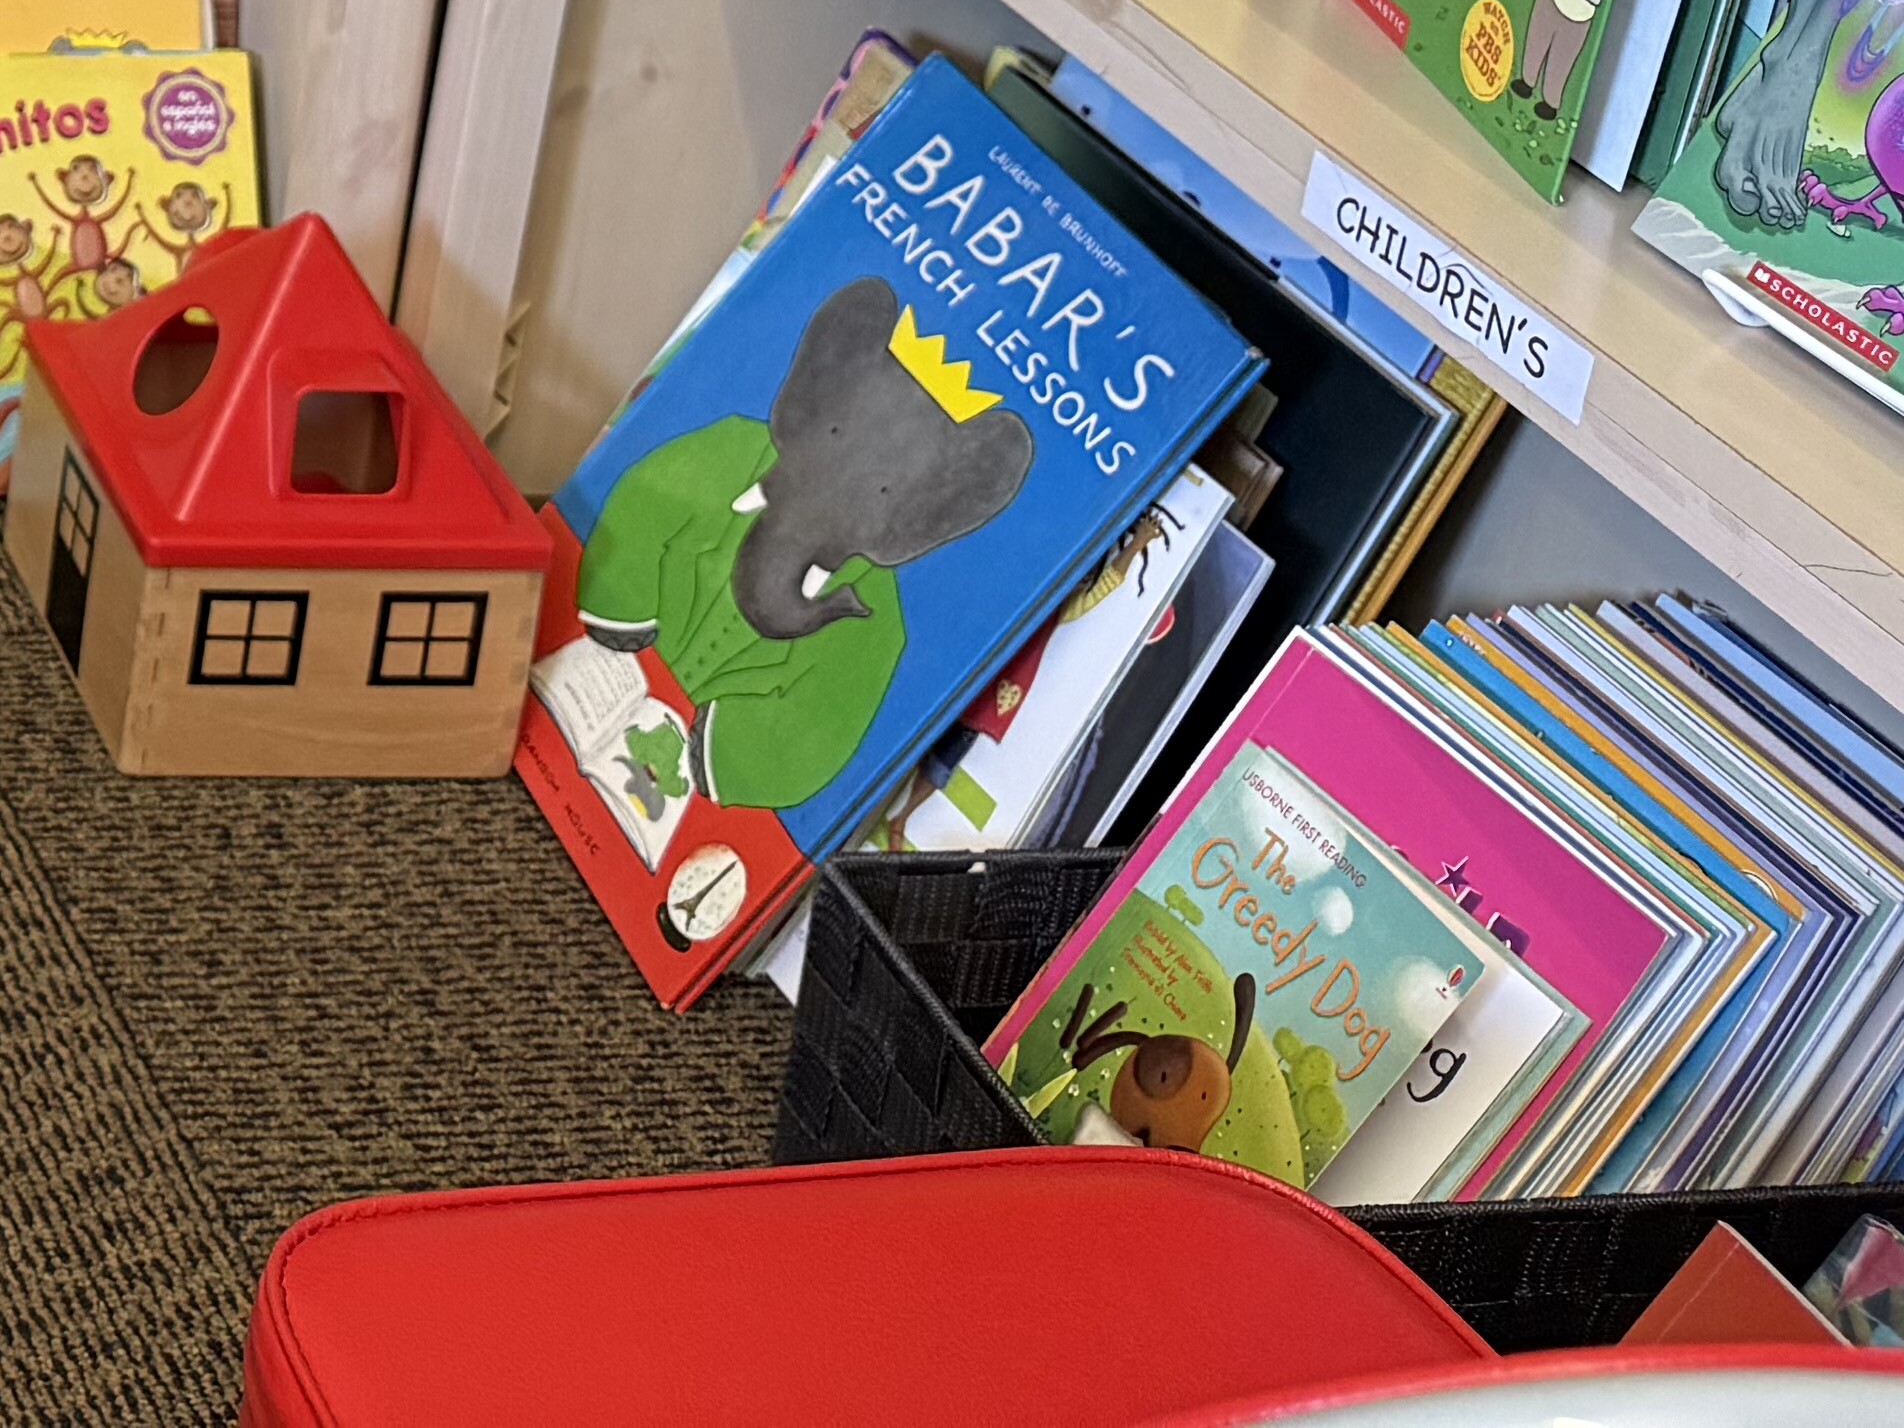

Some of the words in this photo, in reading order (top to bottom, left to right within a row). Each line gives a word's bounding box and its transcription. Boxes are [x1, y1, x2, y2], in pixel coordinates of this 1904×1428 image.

[1463, 41, 1503, 89] KIDS
[1475, 20, 1503, 66] PBS
[836, 163, 975, 307] FRENCH
[976, 309, 1137, 476] LESSONS
[892, 134, 1176, 411] BABAR'S
[1337, 197, 1548, 379] CHILDREN'S
[1767, 266, 1897, 367] SCHOLASTIC
[1242, 767, 1293, 819] USBORNE
[1291, 814, 1322, 844] FIRST
[1318, 840, 1368, 889] READING
[1251, 827, 1296, 895] The
[1190, 837, 1326, 995] Greedy
[1310, 957, 1392, 1082] Dog
